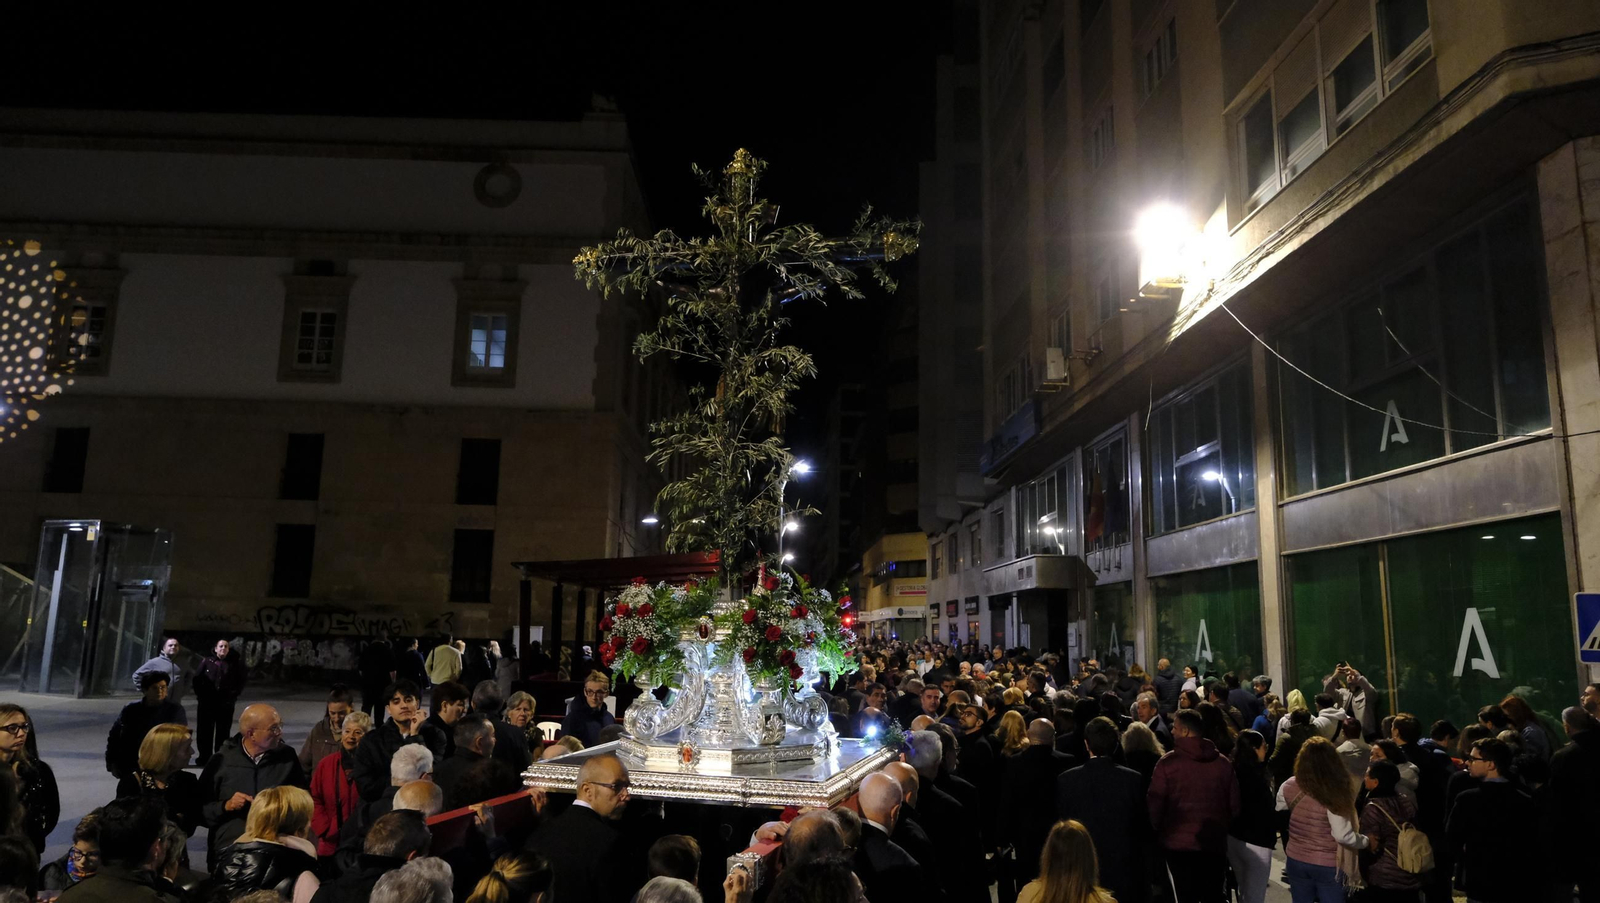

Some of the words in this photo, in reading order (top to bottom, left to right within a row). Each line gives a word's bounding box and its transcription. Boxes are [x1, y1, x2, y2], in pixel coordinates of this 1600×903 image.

[1379, 399, 1410, 453] A
[1195, 618, 1213, 663] A
[1454, 607, 1501, 679] A
